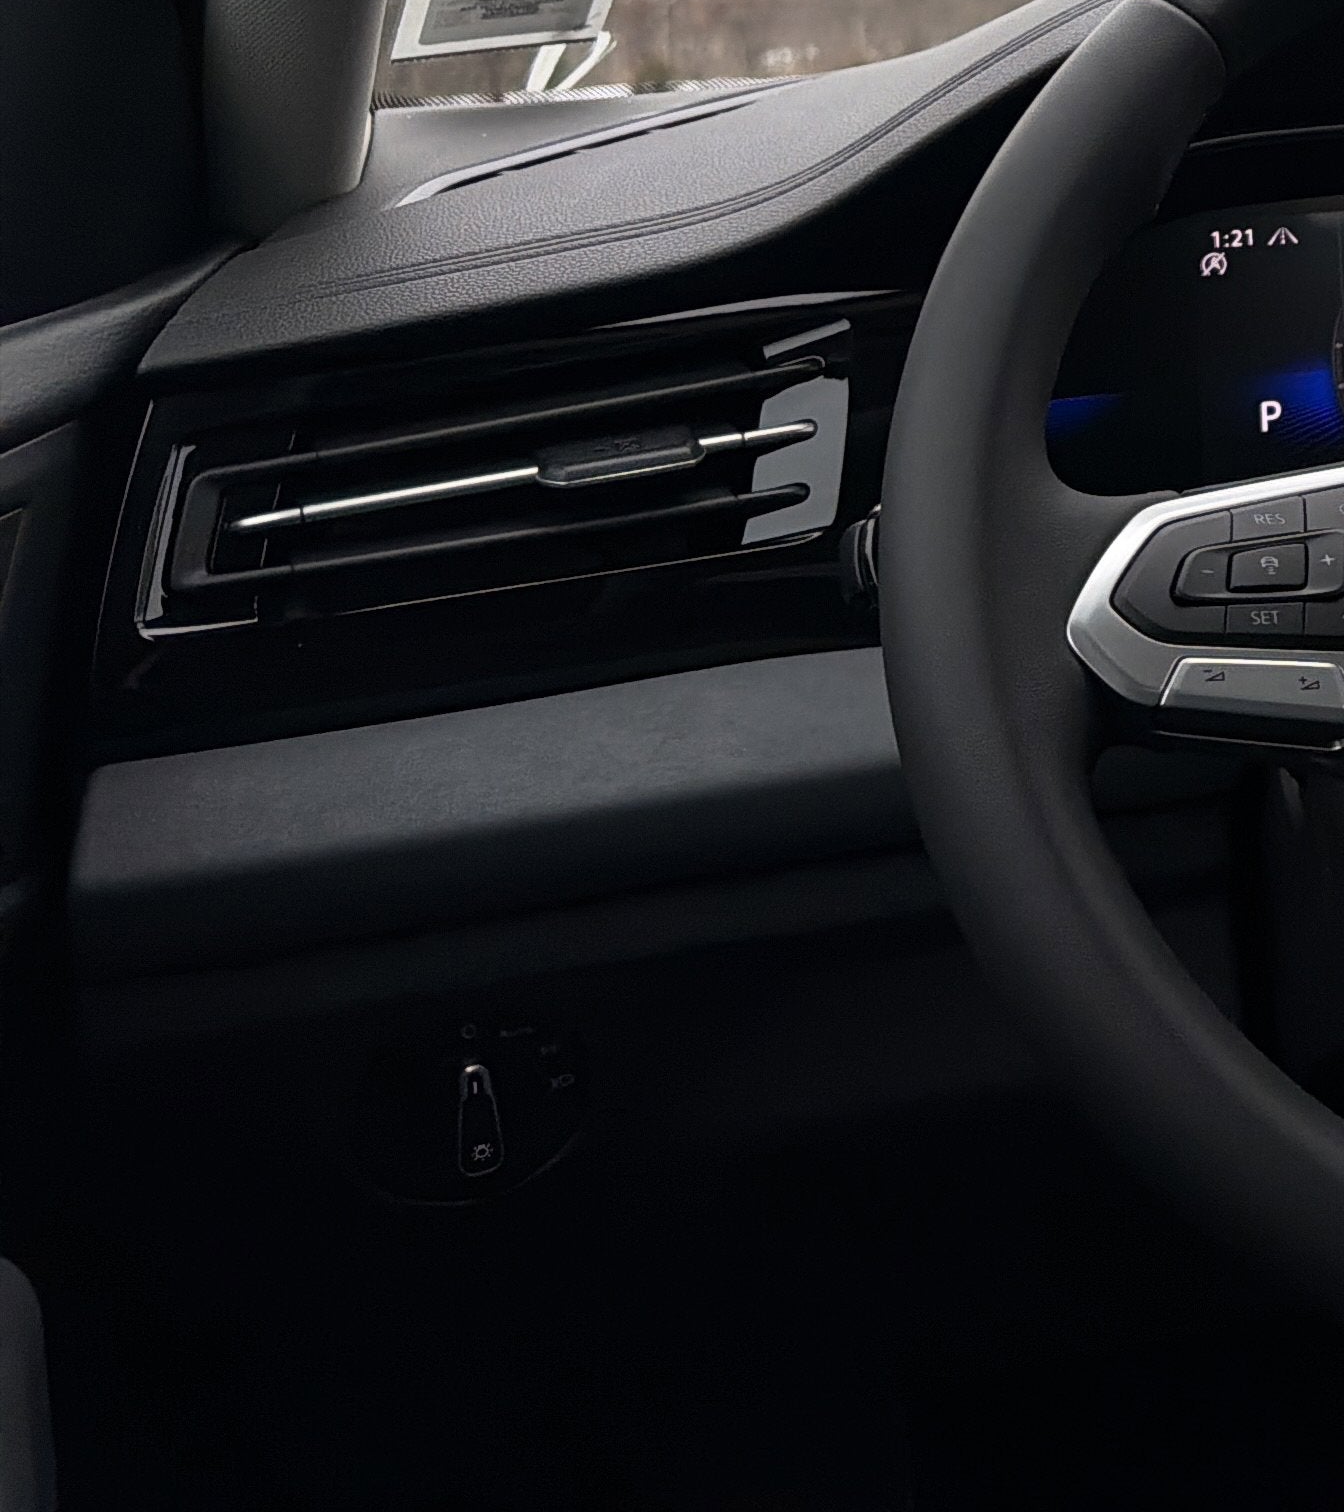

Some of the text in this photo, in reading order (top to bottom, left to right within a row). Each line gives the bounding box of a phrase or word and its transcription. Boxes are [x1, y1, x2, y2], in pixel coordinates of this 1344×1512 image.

[1210, 228, 1254, 248] 1:21
[1259, 400, 1283, 433] P
[1253, 512, 1286, 527] RES
[1250, 610, 1280, 626] SET
